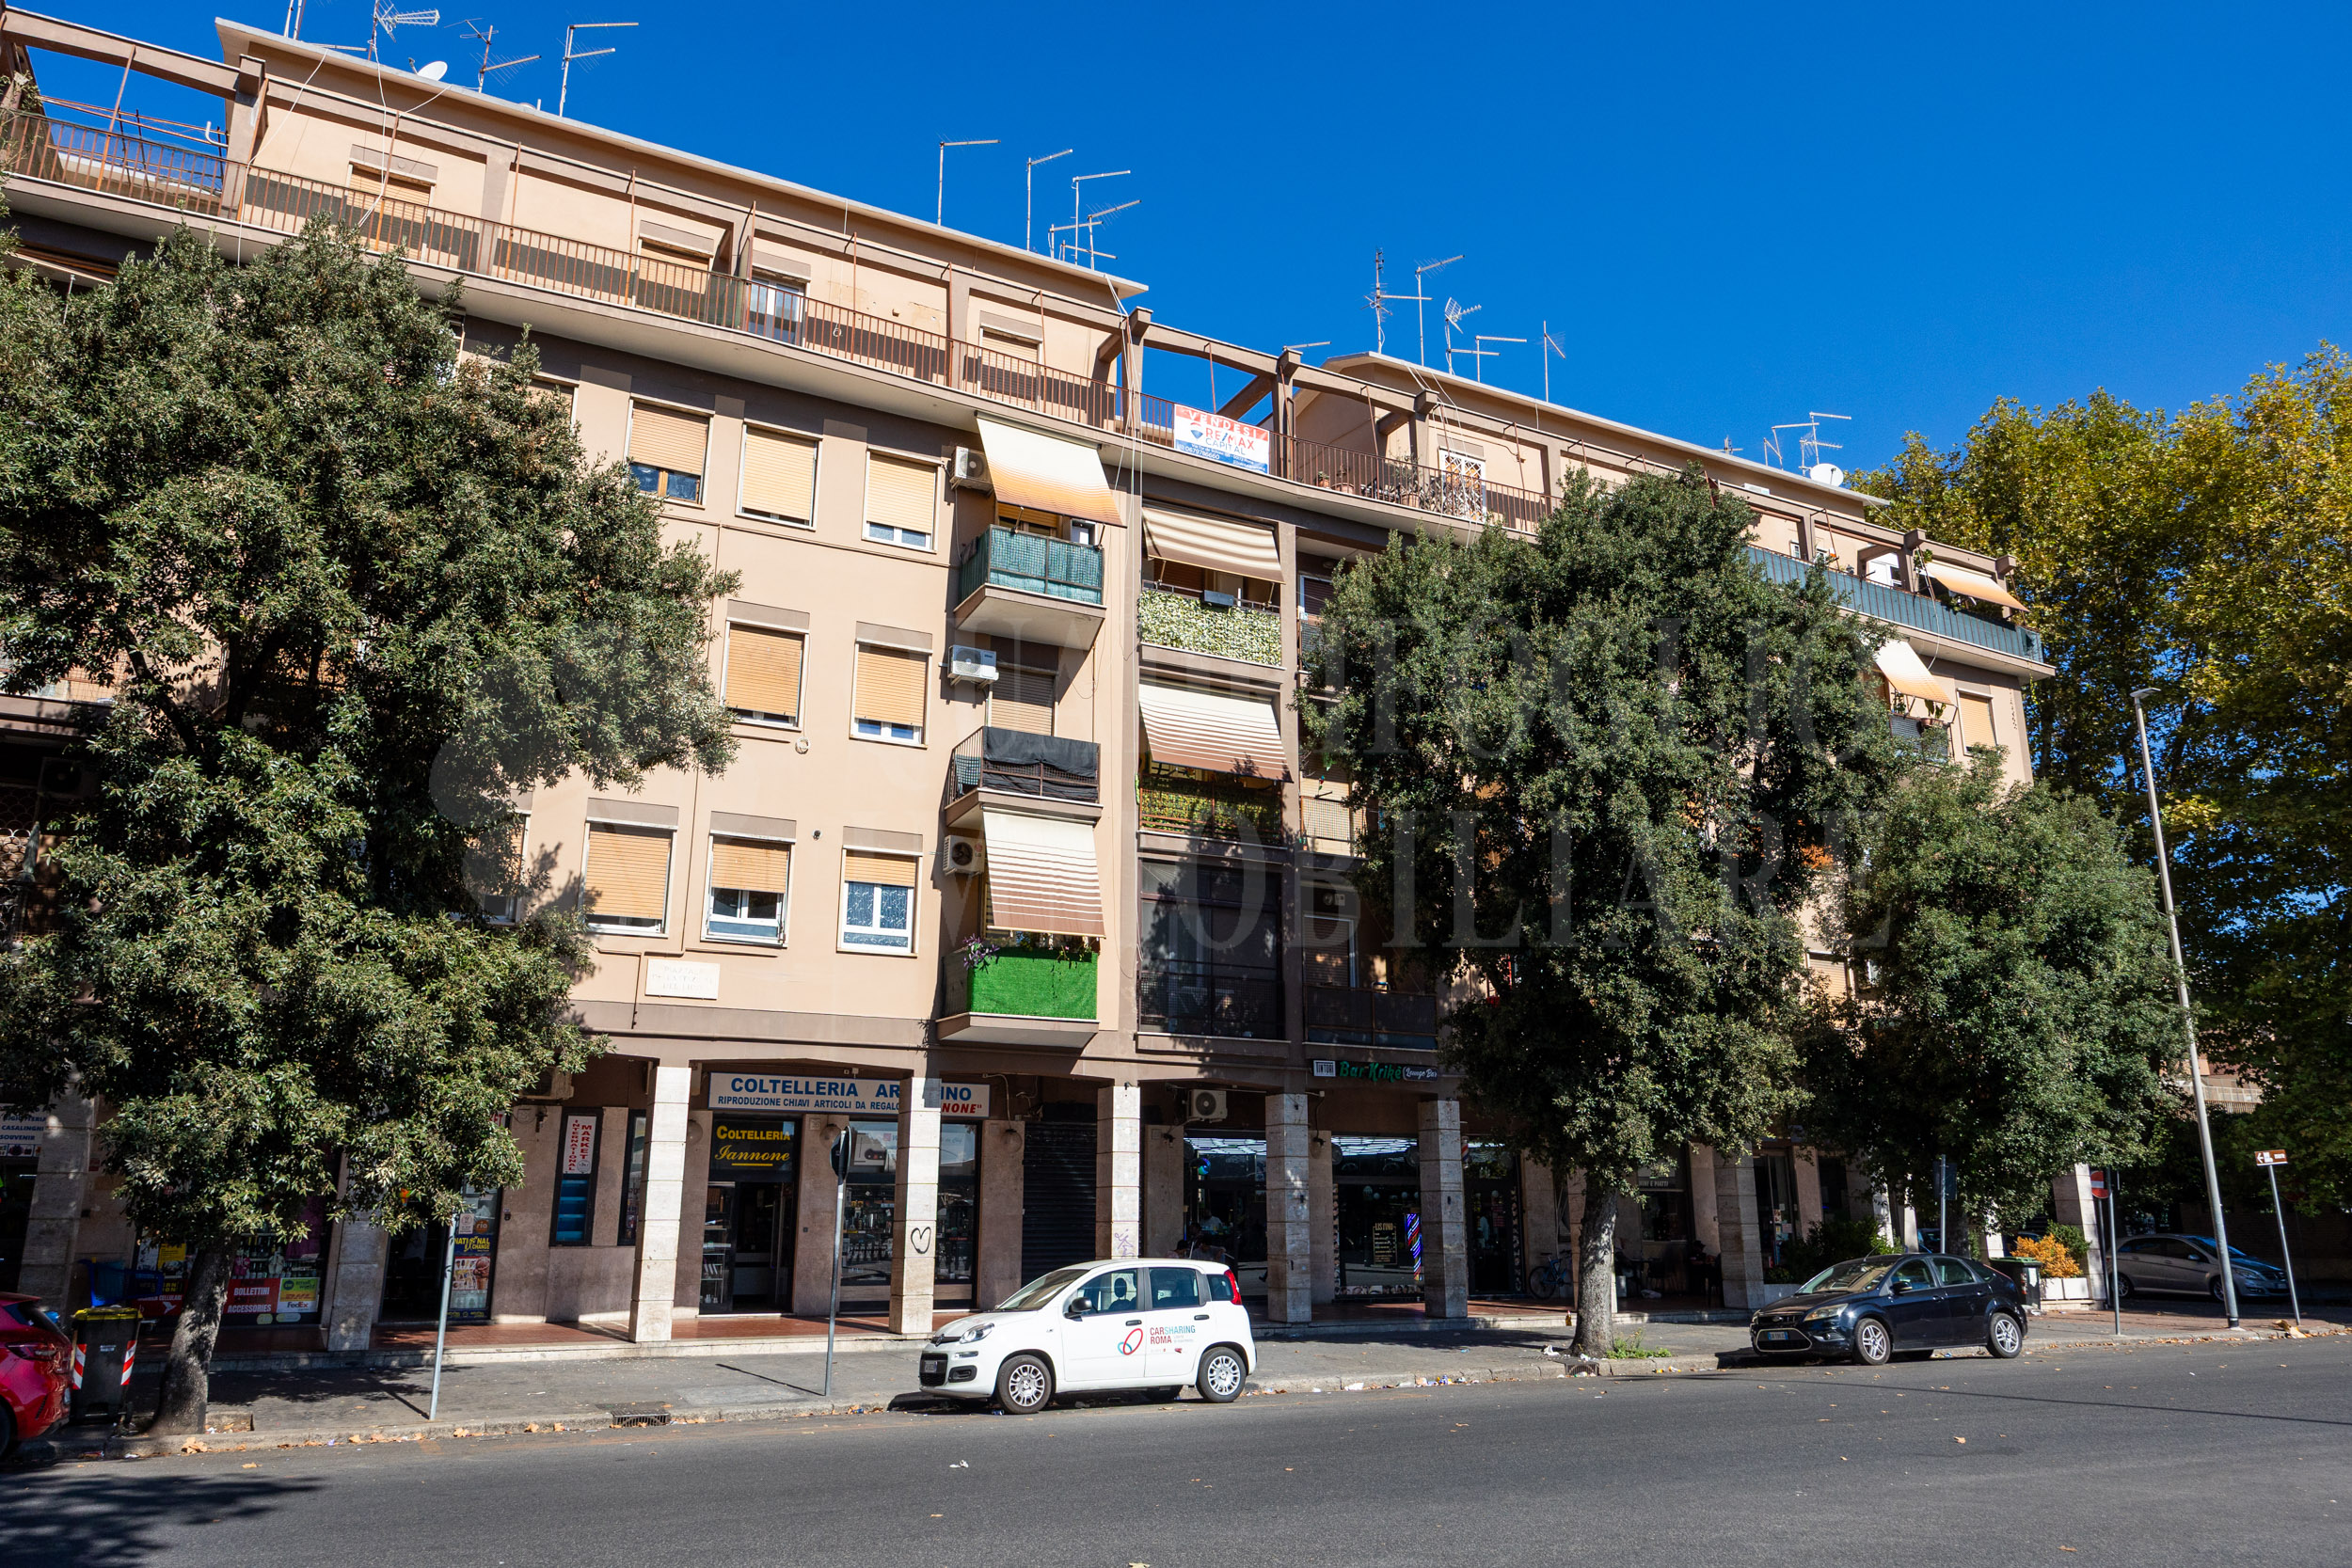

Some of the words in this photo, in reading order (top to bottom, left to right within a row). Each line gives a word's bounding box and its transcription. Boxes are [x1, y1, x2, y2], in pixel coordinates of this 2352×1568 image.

[1188, 410, 1257, 438] VENDESI
[1205, 427, 1255, 451] RE/MAX
[1205, 437, 1246, 455] CAPITAL
[1339, 1060, 1365, 1077] Bar
[1425, 1068, 1438, 1078] Bar
[730, 1077, 859, 1097] COLTELLERIA
[717, 1095, 781, 1107] RIPRODUZIONE
[783, 1098, 810, 1108] CHIAVI
[814, 1099, 851, 1109] ARTICOLI
[855, 1101, 866, 1110] DA
[716, 1125, 791, 1141] COLTELLERIA
[568, 1118, 580, 1171] INTERNATIONAL
[580, 1124, 593, 1160] MARKET
[714, 1145, 791, 1162] Iannone
[233, 1287, 270, 1296] BOLLETTINI
[227, 1304, 271, 1313] ACCESSORIES
[1150, 1324, 1196, 1336] CARSHARING
[1150, 1336, 1172, 1345] ROMA
